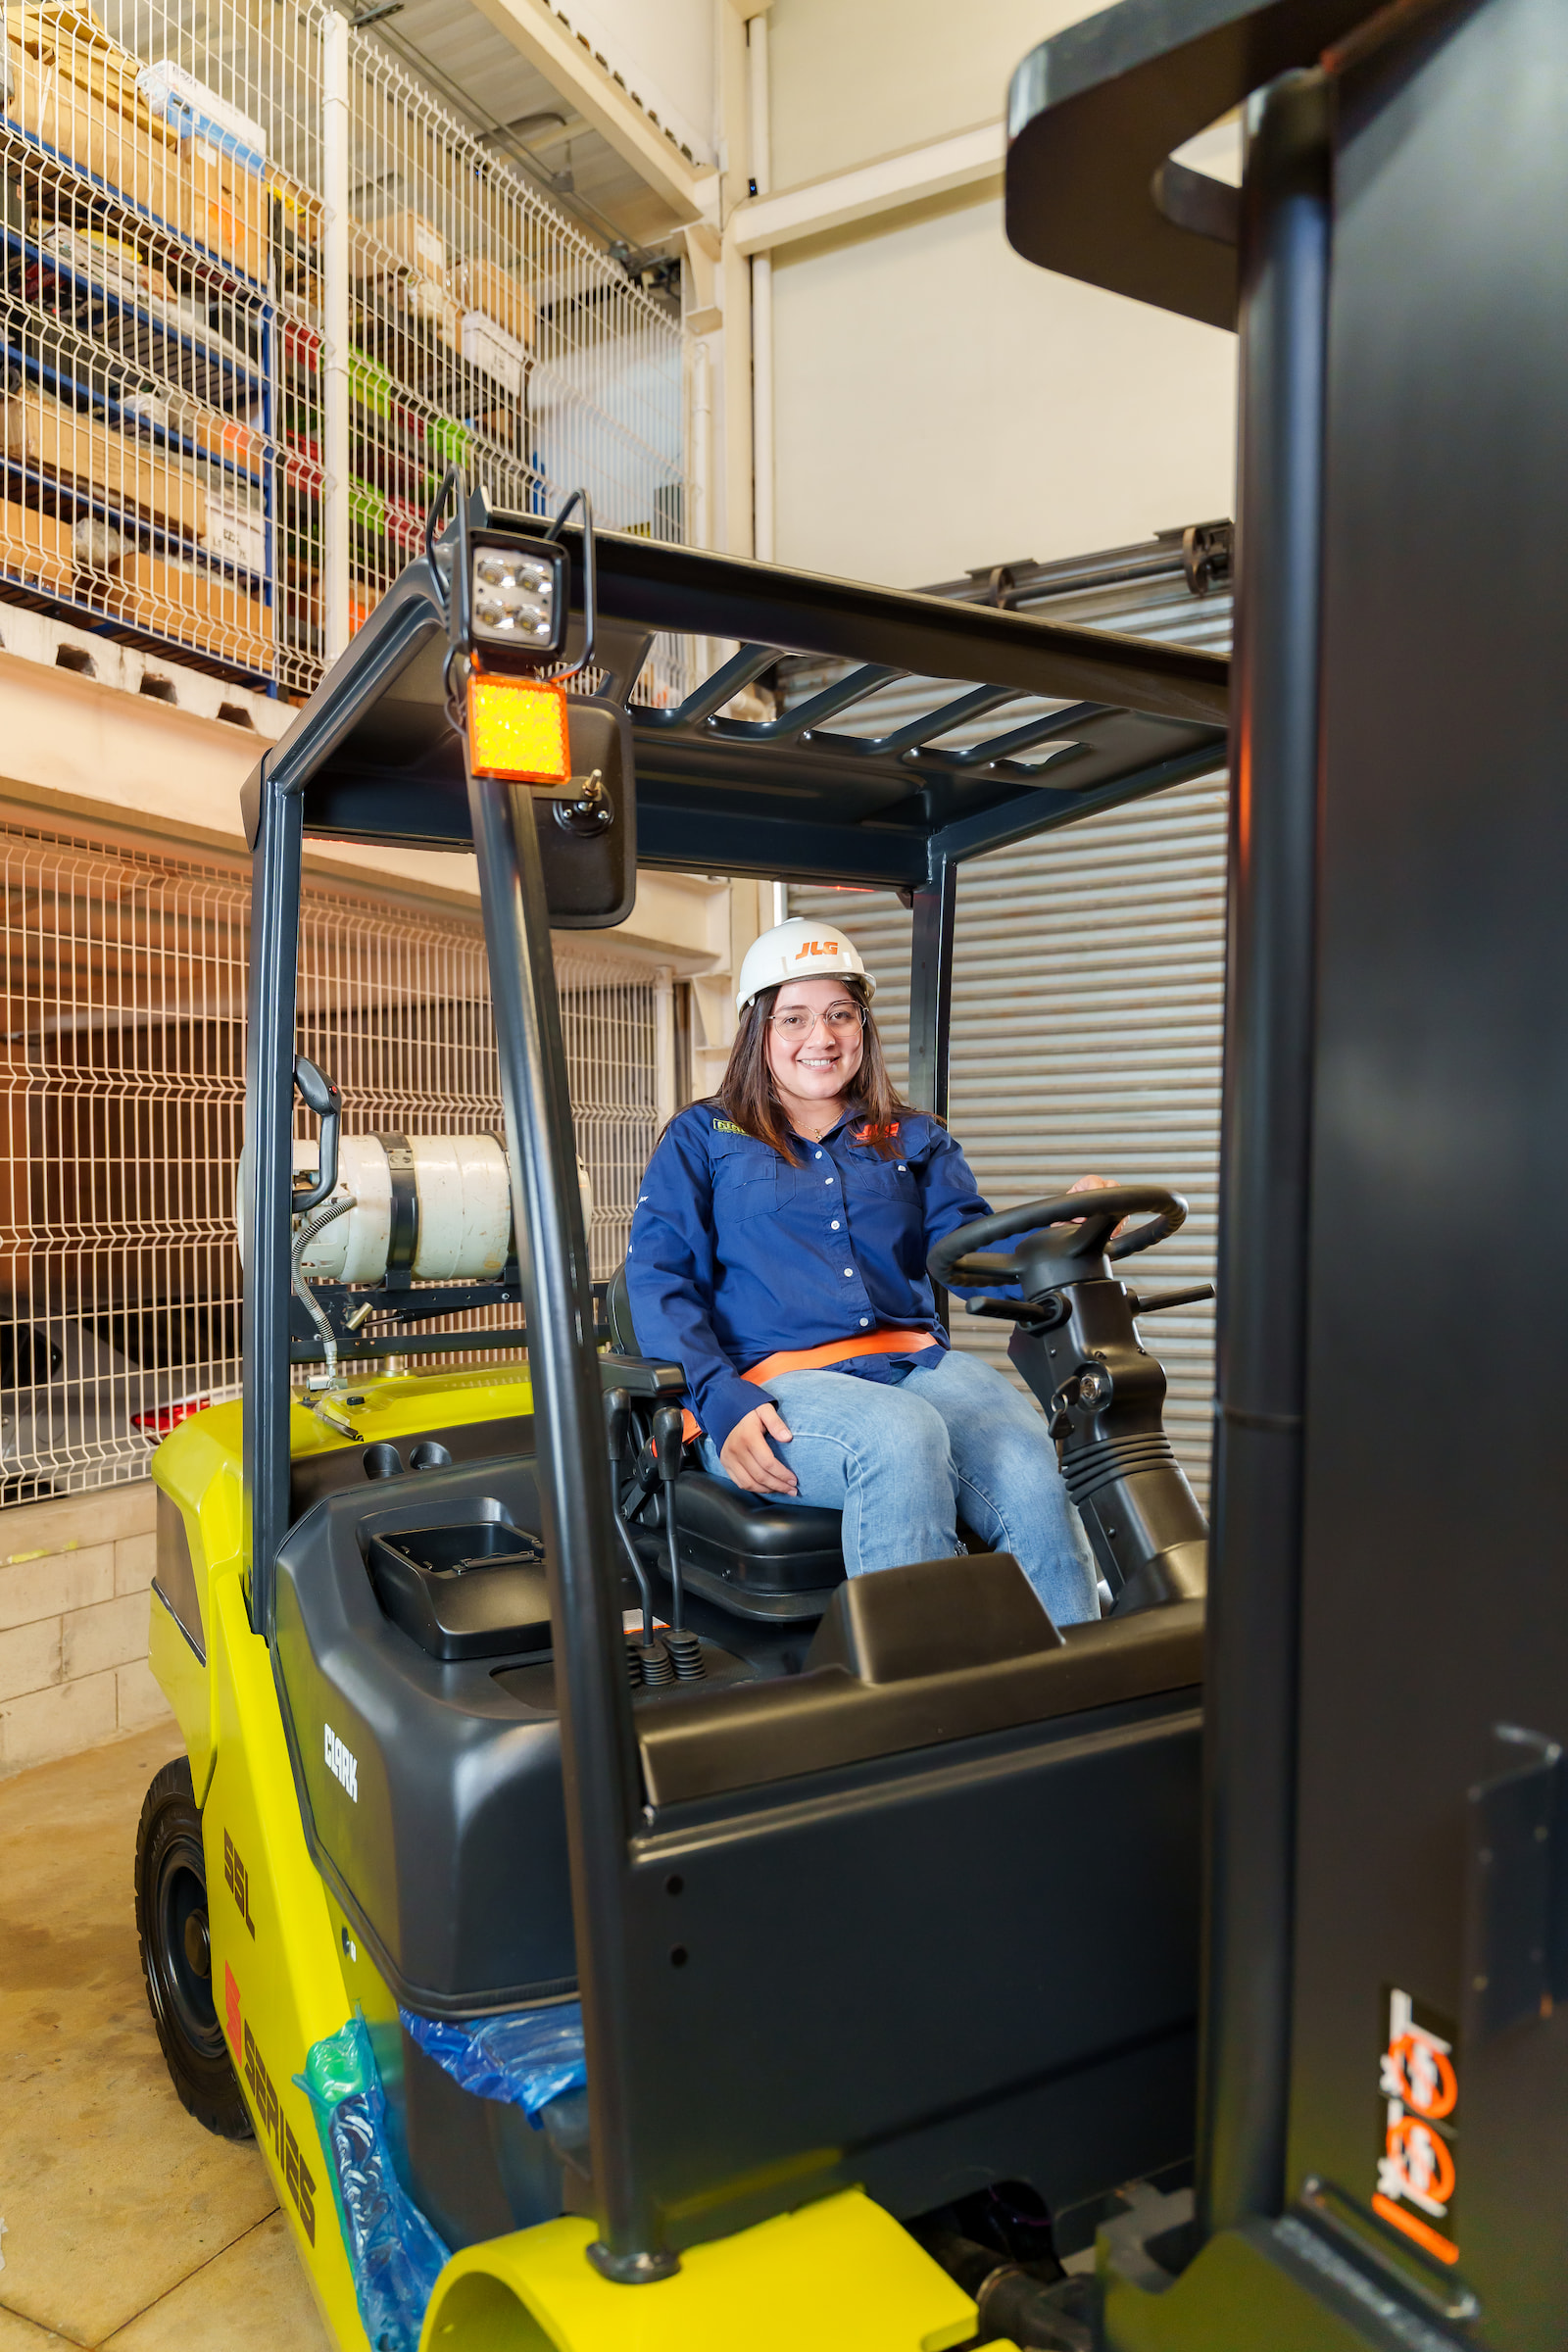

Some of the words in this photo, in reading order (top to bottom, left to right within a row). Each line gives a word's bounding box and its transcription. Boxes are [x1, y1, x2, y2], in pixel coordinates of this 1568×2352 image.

[795, 941, 839, 960] JLG
[324, 1723, 358, 1803] CLARK
[244, 2018, 317, 2249] SERIES
